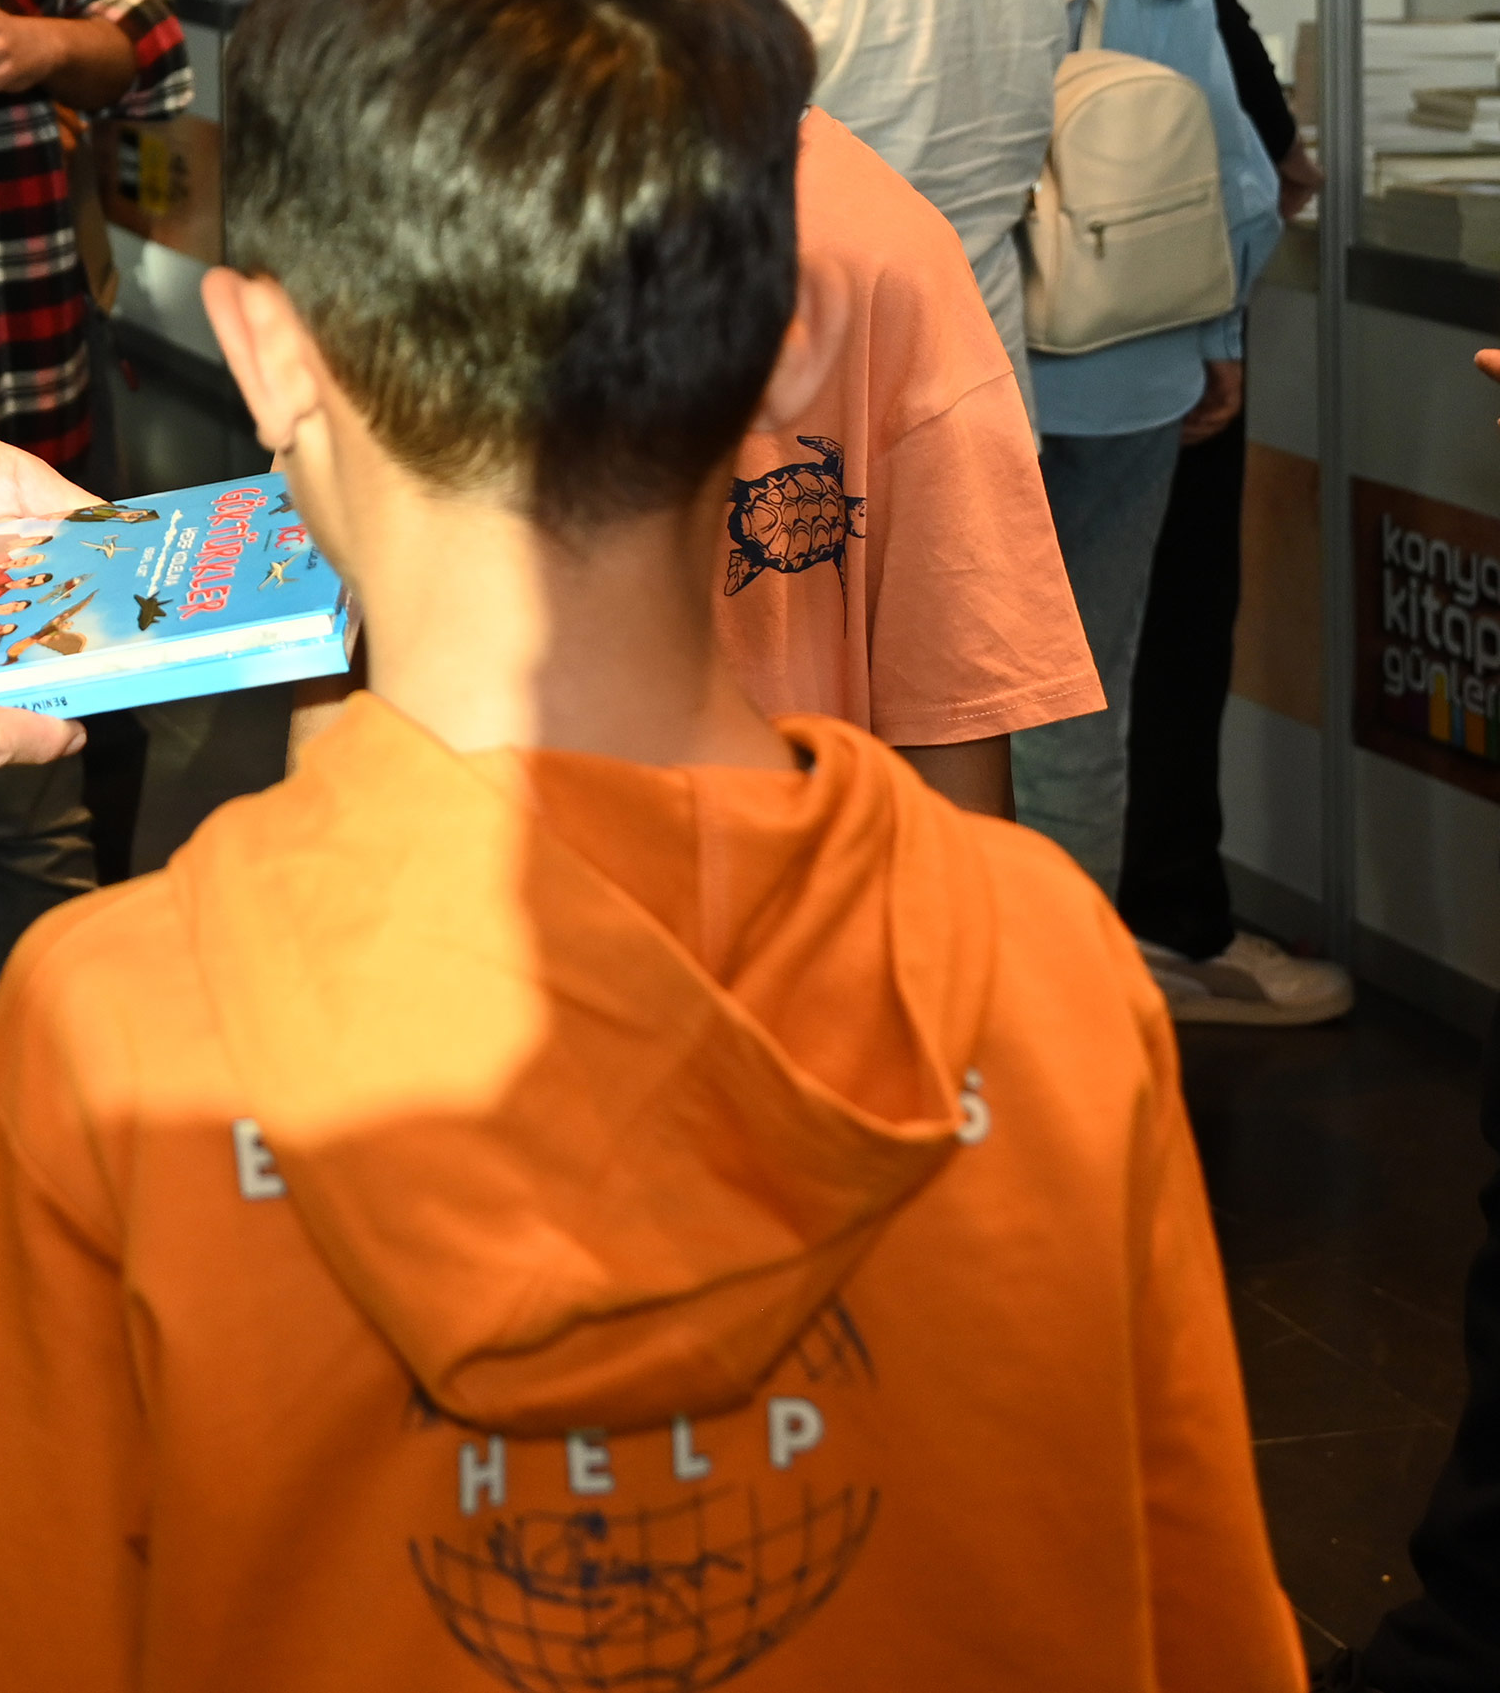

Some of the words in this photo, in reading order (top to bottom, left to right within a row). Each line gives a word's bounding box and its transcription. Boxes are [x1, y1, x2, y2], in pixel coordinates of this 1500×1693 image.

[177, 488, 268, 620] GÖKTÜRKLER
[1382, 512, 1500, 606] konya
[1383, 568, 1500, 676] kitap
[1383, 645, 1500, 719] günler
[459, 1395, 824, 1516] HELP
